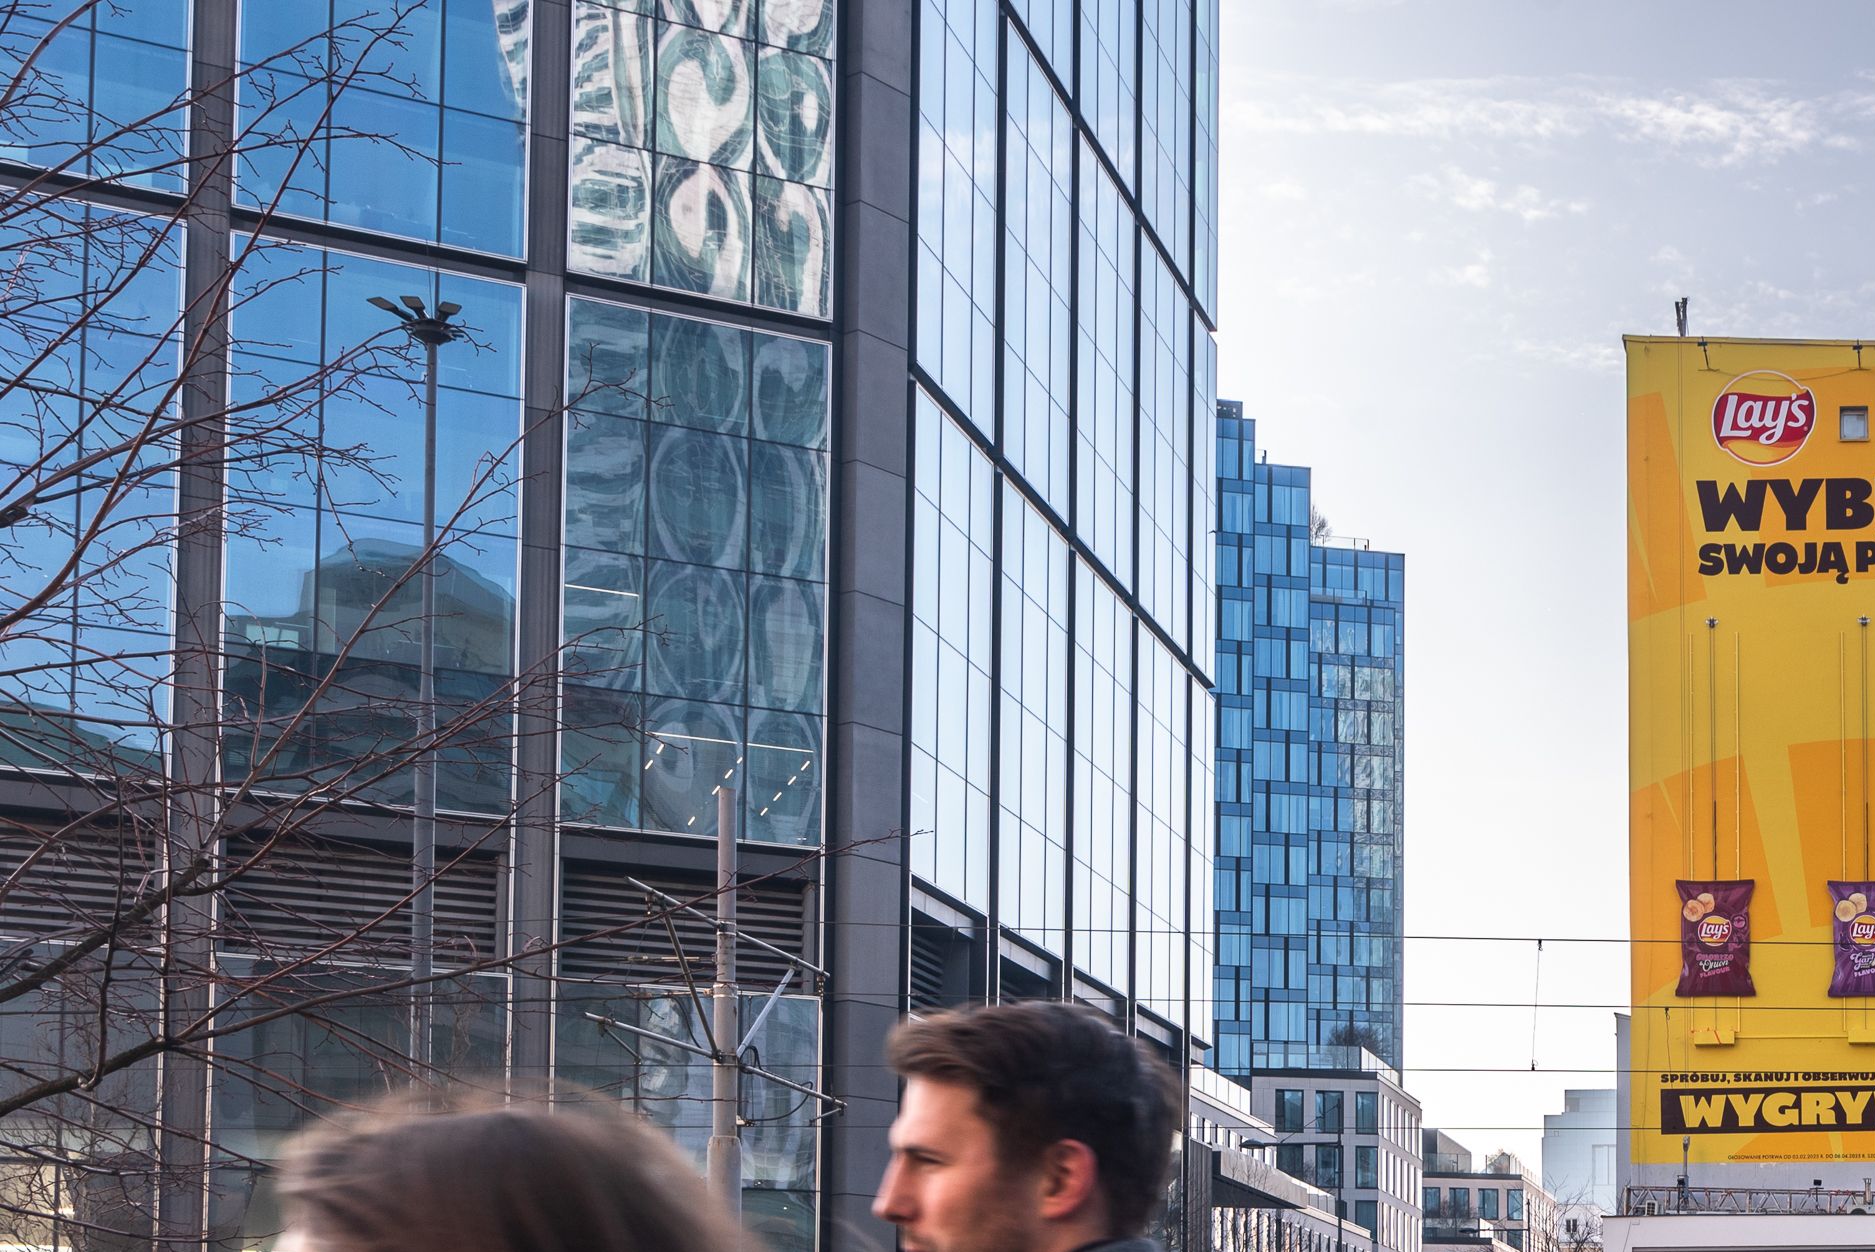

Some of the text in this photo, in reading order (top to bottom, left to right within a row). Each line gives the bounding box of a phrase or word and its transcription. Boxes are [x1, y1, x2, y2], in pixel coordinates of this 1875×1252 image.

[1720, 393, 1809, 444] Lay's
[1698, 543, 1849, 584] SWOJĄ
[1701, 922, 1729, 939] Lay's
[1660, 1071, 1730, 1084] SPRÓBUJ,
[1733, 1073, 1790, 1083] SKANUJ
